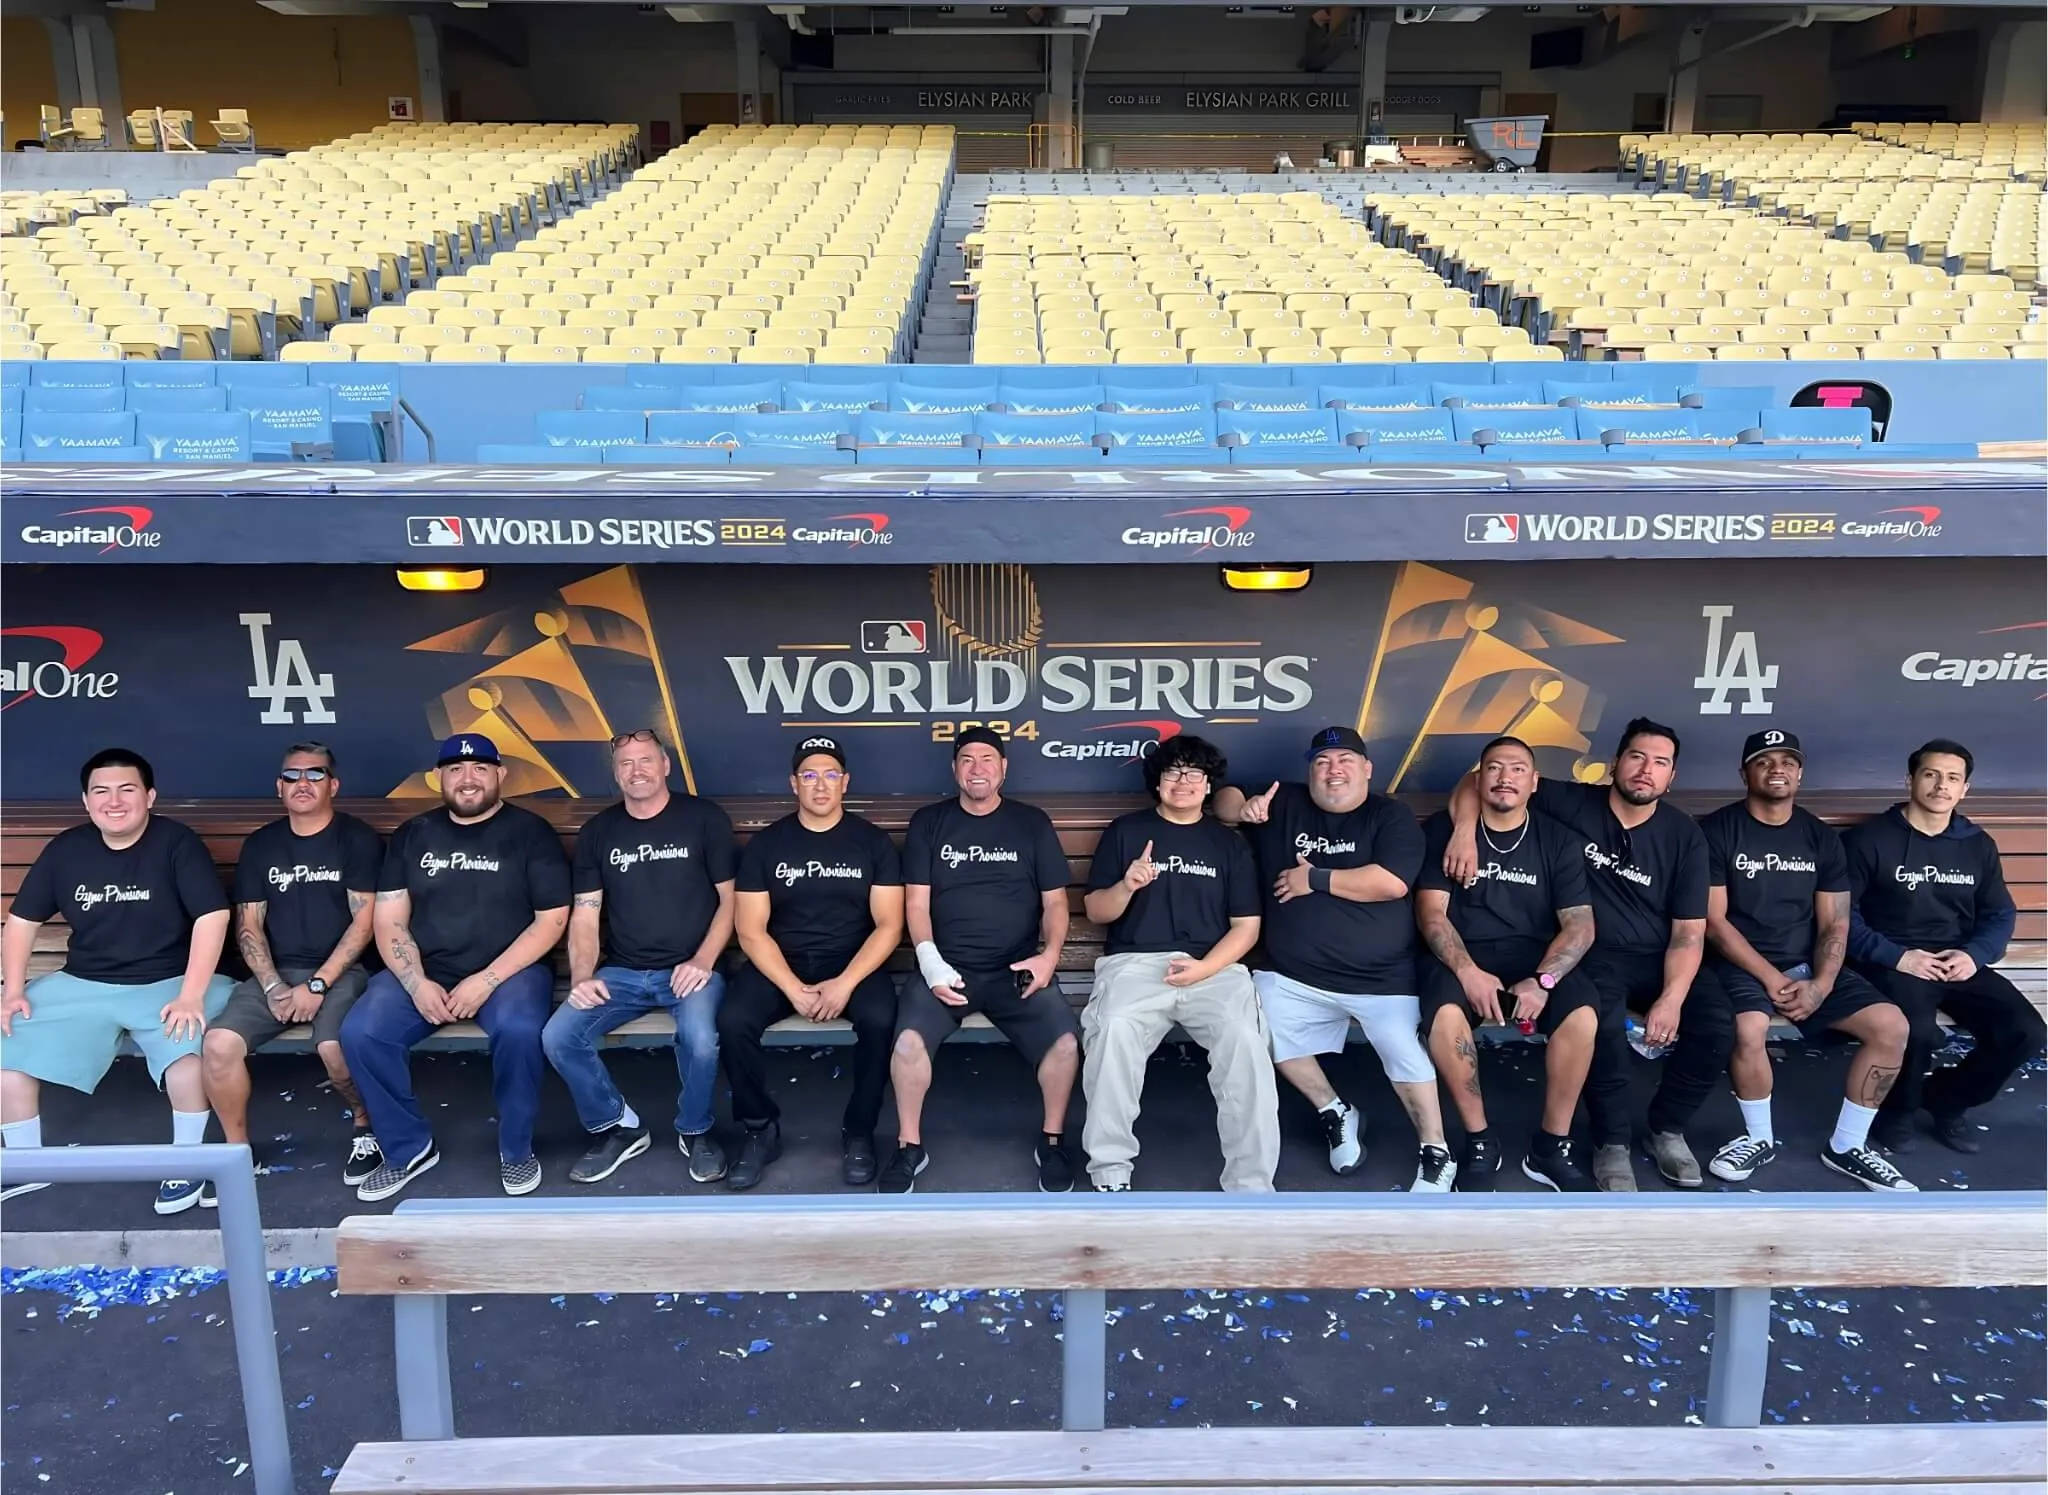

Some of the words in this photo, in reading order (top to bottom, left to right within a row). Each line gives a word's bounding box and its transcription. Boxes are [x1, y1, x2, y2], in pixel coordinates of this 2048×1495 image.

[918, 92, 985, 108] ELYSIAN
[991, 92, 1033, 108] PARK
[1108, 95, 1135, 104] COLD
[1138, 95, 1161, 104] BEER
[1186, 92, 1253, 107] ELYSIAN
[1259, 92, 1301, 107] PARK
[1306, 92, 1351, 107] GRILL
[466, 517, 594, 545] WORLD
[598, 518, 715, 549] SERIES
[720, 523, 786, 540] 2024
[1524, 514, 1647, 542] WORLD
[1651, 514, 1765, 543] SERIES
[1771, 518, 1836, 534] 2024
[239, 612, 337, 724] LA
[1693, 605, 1779, 714] LA
[724, 656, 1027, 714] WORLD
[1041, 655, 1313, 718] SERIES
[460, 740, 474, 755] LA
[1764, 730, 1785, 746] D
[940, 845, 968, 868] Gym
[968, 846, 1018, 863] Provisions
[775, 863, 805, 886] Gym
[806, 860, 862, 879] Provisions
